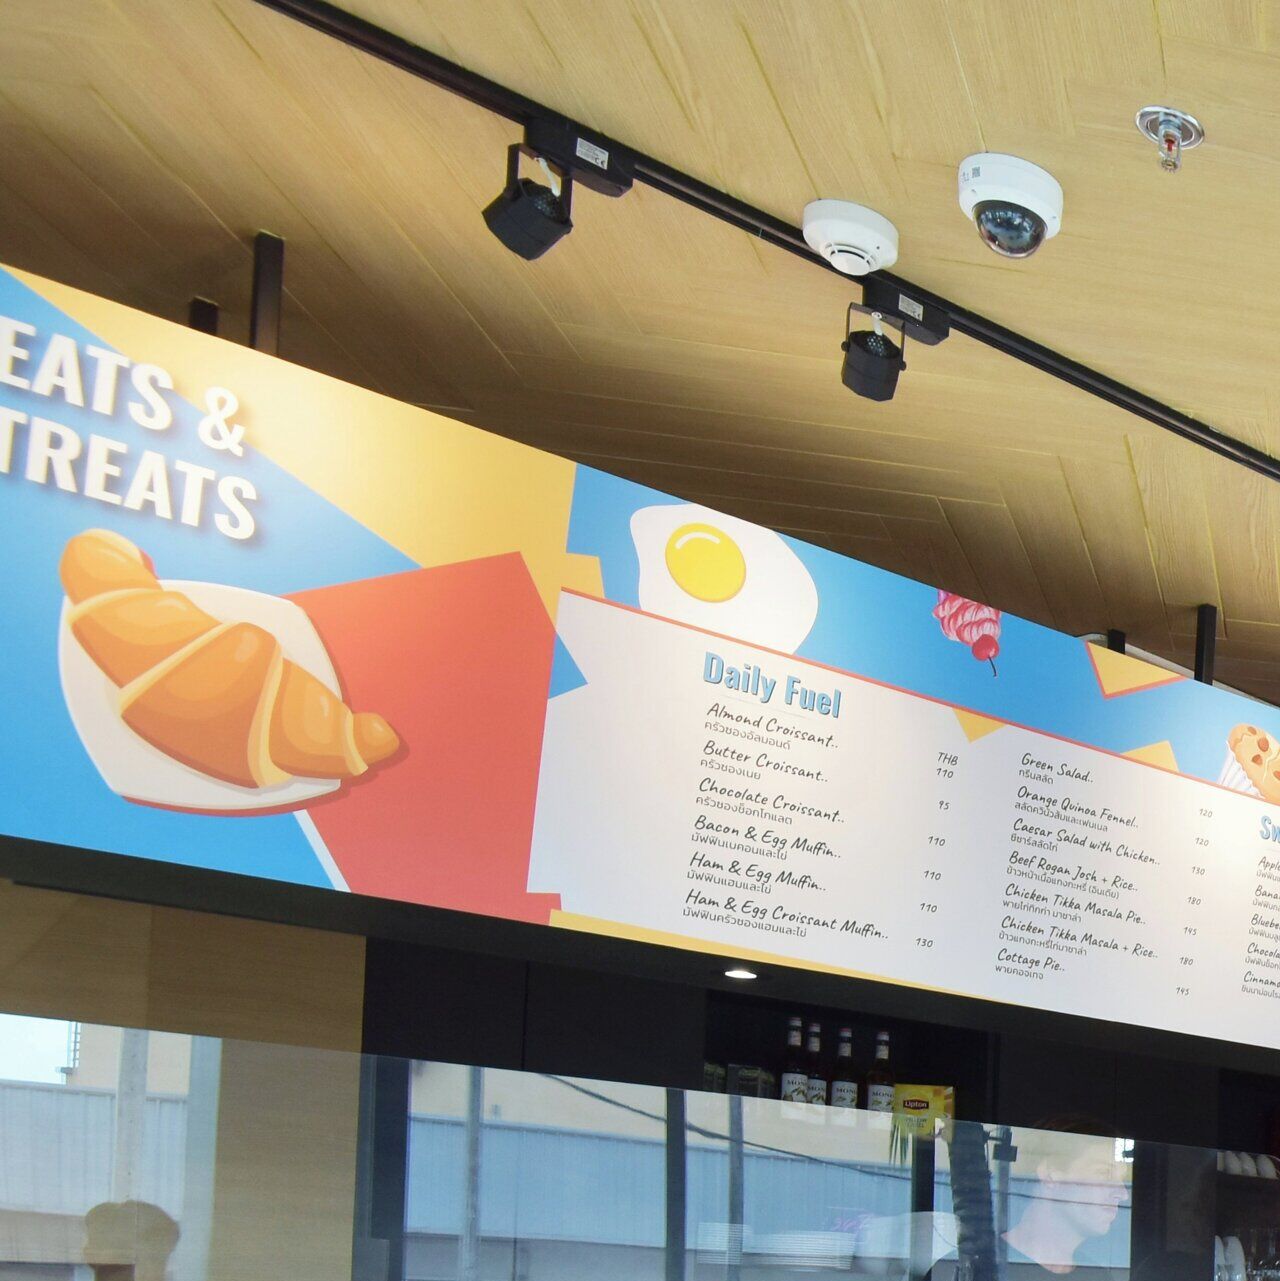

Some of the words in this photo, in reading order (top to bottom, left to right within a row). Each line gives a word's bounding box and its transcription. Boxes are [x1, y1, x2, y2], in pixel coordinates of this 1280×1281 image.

[0, 315, 174, 431] EATS
[198, 386, 246, 457] &
[0, 406, 257, 540] TREATS
[703, 651, 776, 704] Daily
[785, 675, 841, 718] Fuel
[706, 702, 763, 729] Almond
[703, 740, 751, 763] Butter
[937, 751, 959, 767] THB
[936, 767, 954, 779] 110
[1021, 752, 1054, 773] Green
[699, 777, 769, 805] Chocolate
[1017, 785, 1058, 808] Orange
[1060, 797, 1097, 817] Quinoa
[938, 800, 950, 811] 95
[1198, 808, 1213, 818] 120
[694, 814, 740, 836] Bacon
[744, 826, 757, 842] &
[761, 830, 788, 850] Egg
[928, 835, 946, 847] 110
[1013, 818, 1053, 838] Caesar
[1056, 829, 1088, 847] Salad
[1089, 840, 1112, 853] with
[1195, 837, 1209, 847] 120
[689, 851, 724, 871] Ham
[728, 860, 742, 876] &
[745, 864, 772, 884] Egg
[923, 869, 942, 881] 110
[1008, 850, 1037, 866] Beef
[1037, 857, 1071, 876] Rogan
[1072, 866, 1097, 882] Josh
[1102, 876, 1108, 884] +
[1191, 866, 1205, 876] 130
[685, 888, 720, 907] Ham
[724, 896, 737, 913] &
[741, 900, 768, 920] Egg
[772, 905, 837, 930] Croissant
[919, 902, 938, 914] 110
[1005, 883, 1048, 903] Chicken
[1053, 894, 1081, 910] Tikka
[1084, 901, 1123, 920] Masala
[1187, 896, 1202, 906] 180
[916, 937, 934, 949] 130
[1001, 915, 1045, 935] Chicken
[1049, 926, 1077, 942] Tikka
[1080, 933, 1119, 950] Masala
[1122, 944, 1129, 952] +
[997, 948, 1040, 969] Cottage
[1179, 956, 1194, 967] 180
[904, 1099, 927, 1109] Lipton
